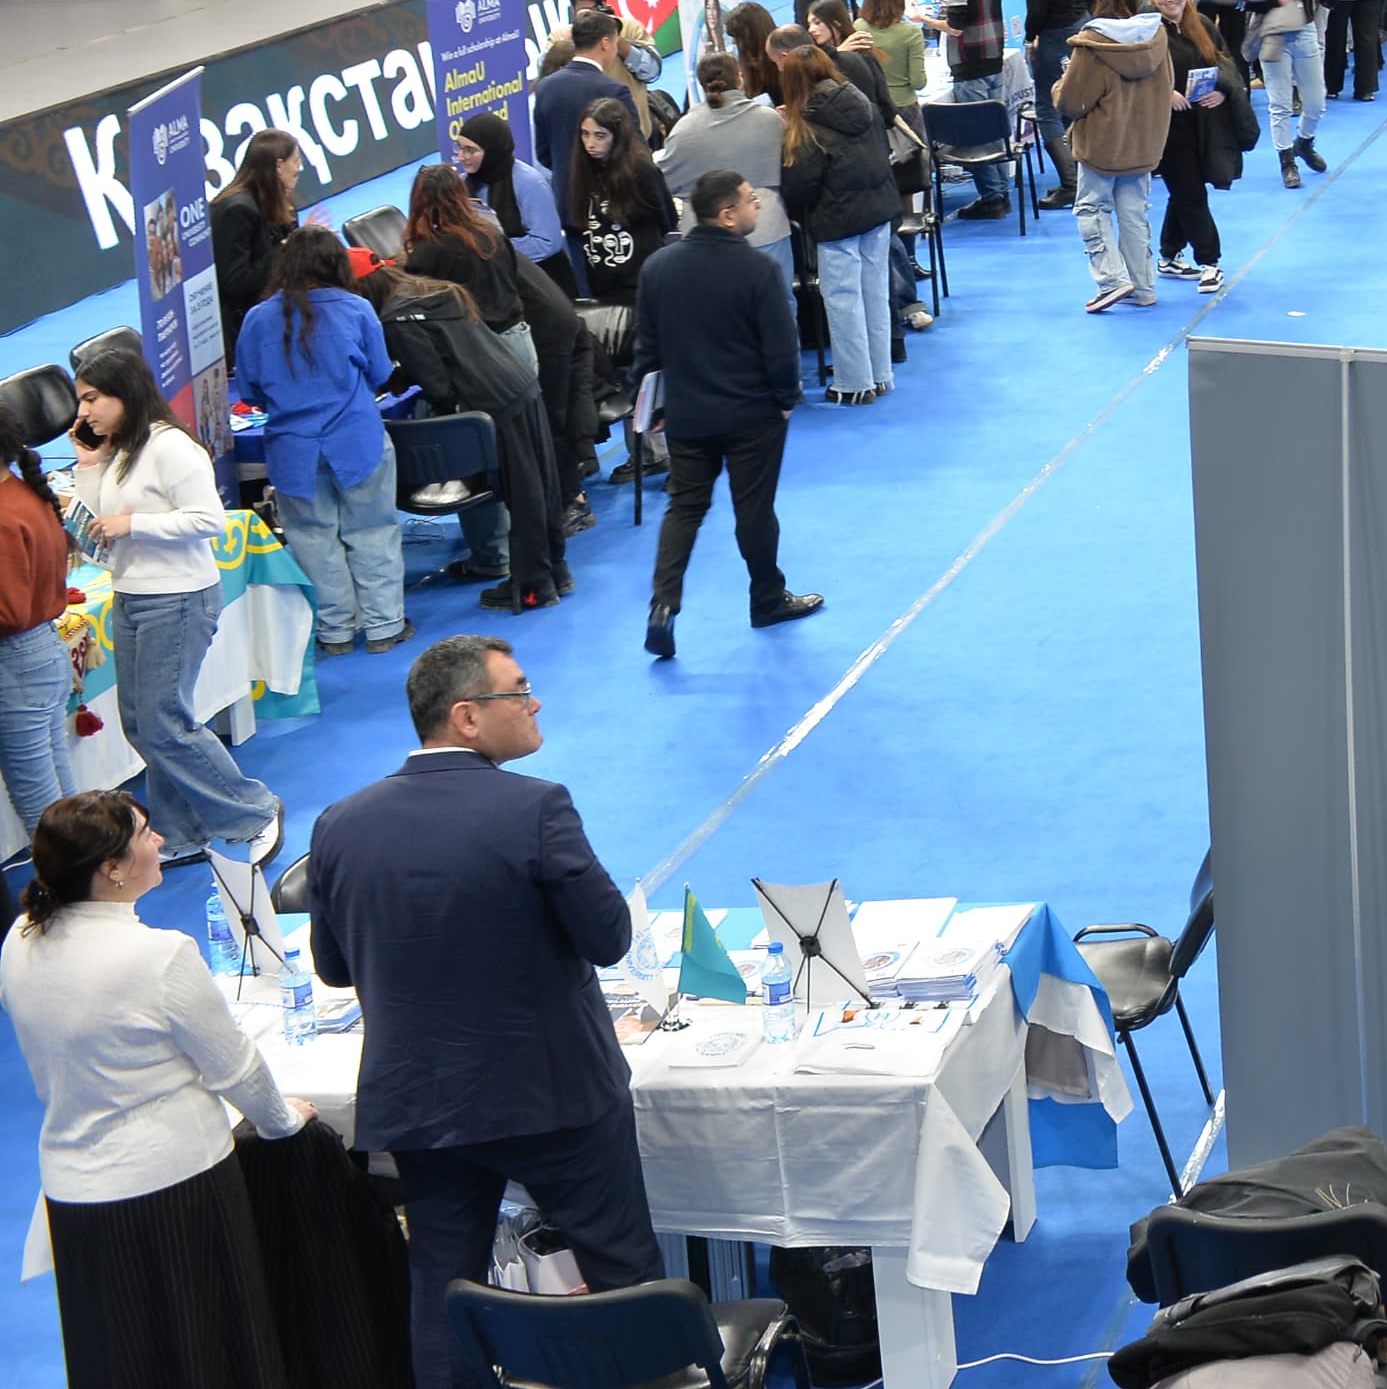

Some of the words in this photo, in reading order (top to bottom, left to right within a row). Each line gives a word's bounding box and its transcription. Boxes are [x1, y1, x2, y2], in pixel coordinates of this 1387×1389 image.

[444, 60, 486, 93] AlmaU
[446, 71, 524, 117] International
[180, 196, 206, 228] ONE
